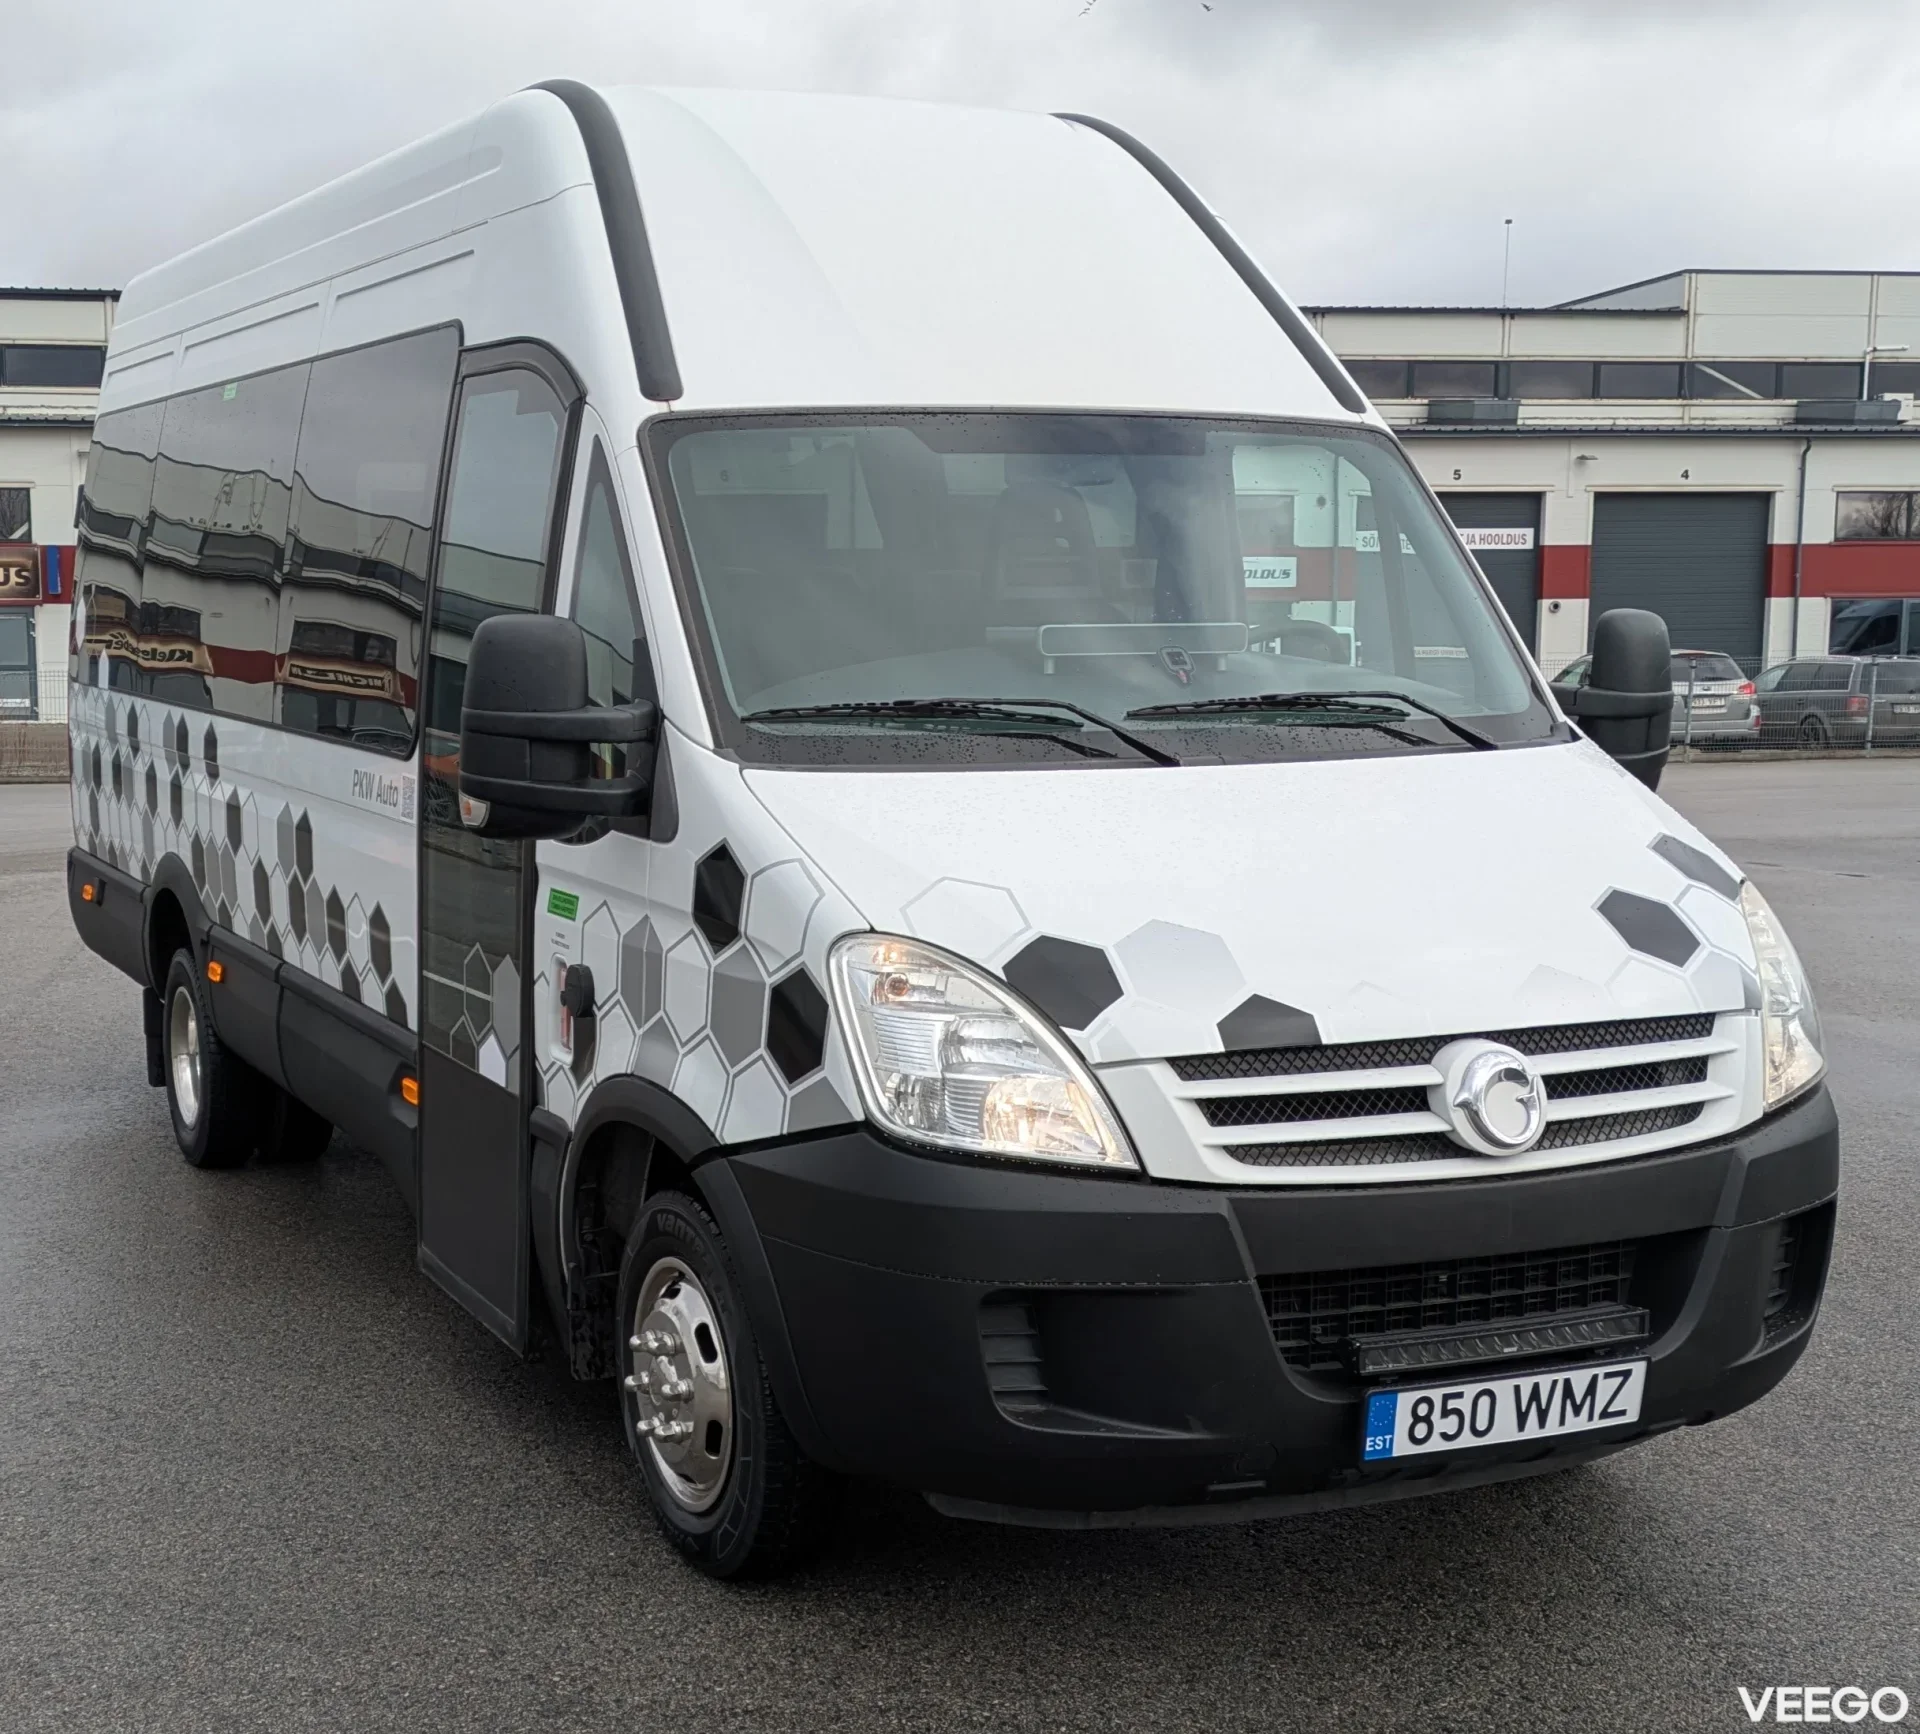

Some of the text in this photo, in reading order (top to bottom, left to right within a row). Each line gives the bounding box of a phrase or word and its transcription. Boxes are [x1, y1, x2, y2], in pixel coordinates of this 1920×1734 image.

[1453, 469, 1462, 480] 5
[1681, 469, 1690, 480] 4
[1479, 533, 1527, 545] HOOLDUS
[352, 769, 398, 807] PKW Auto
[1407, 1368, 1633, 1446] 850 WMZ
[1366, 1434, 1393, 1451] EST
